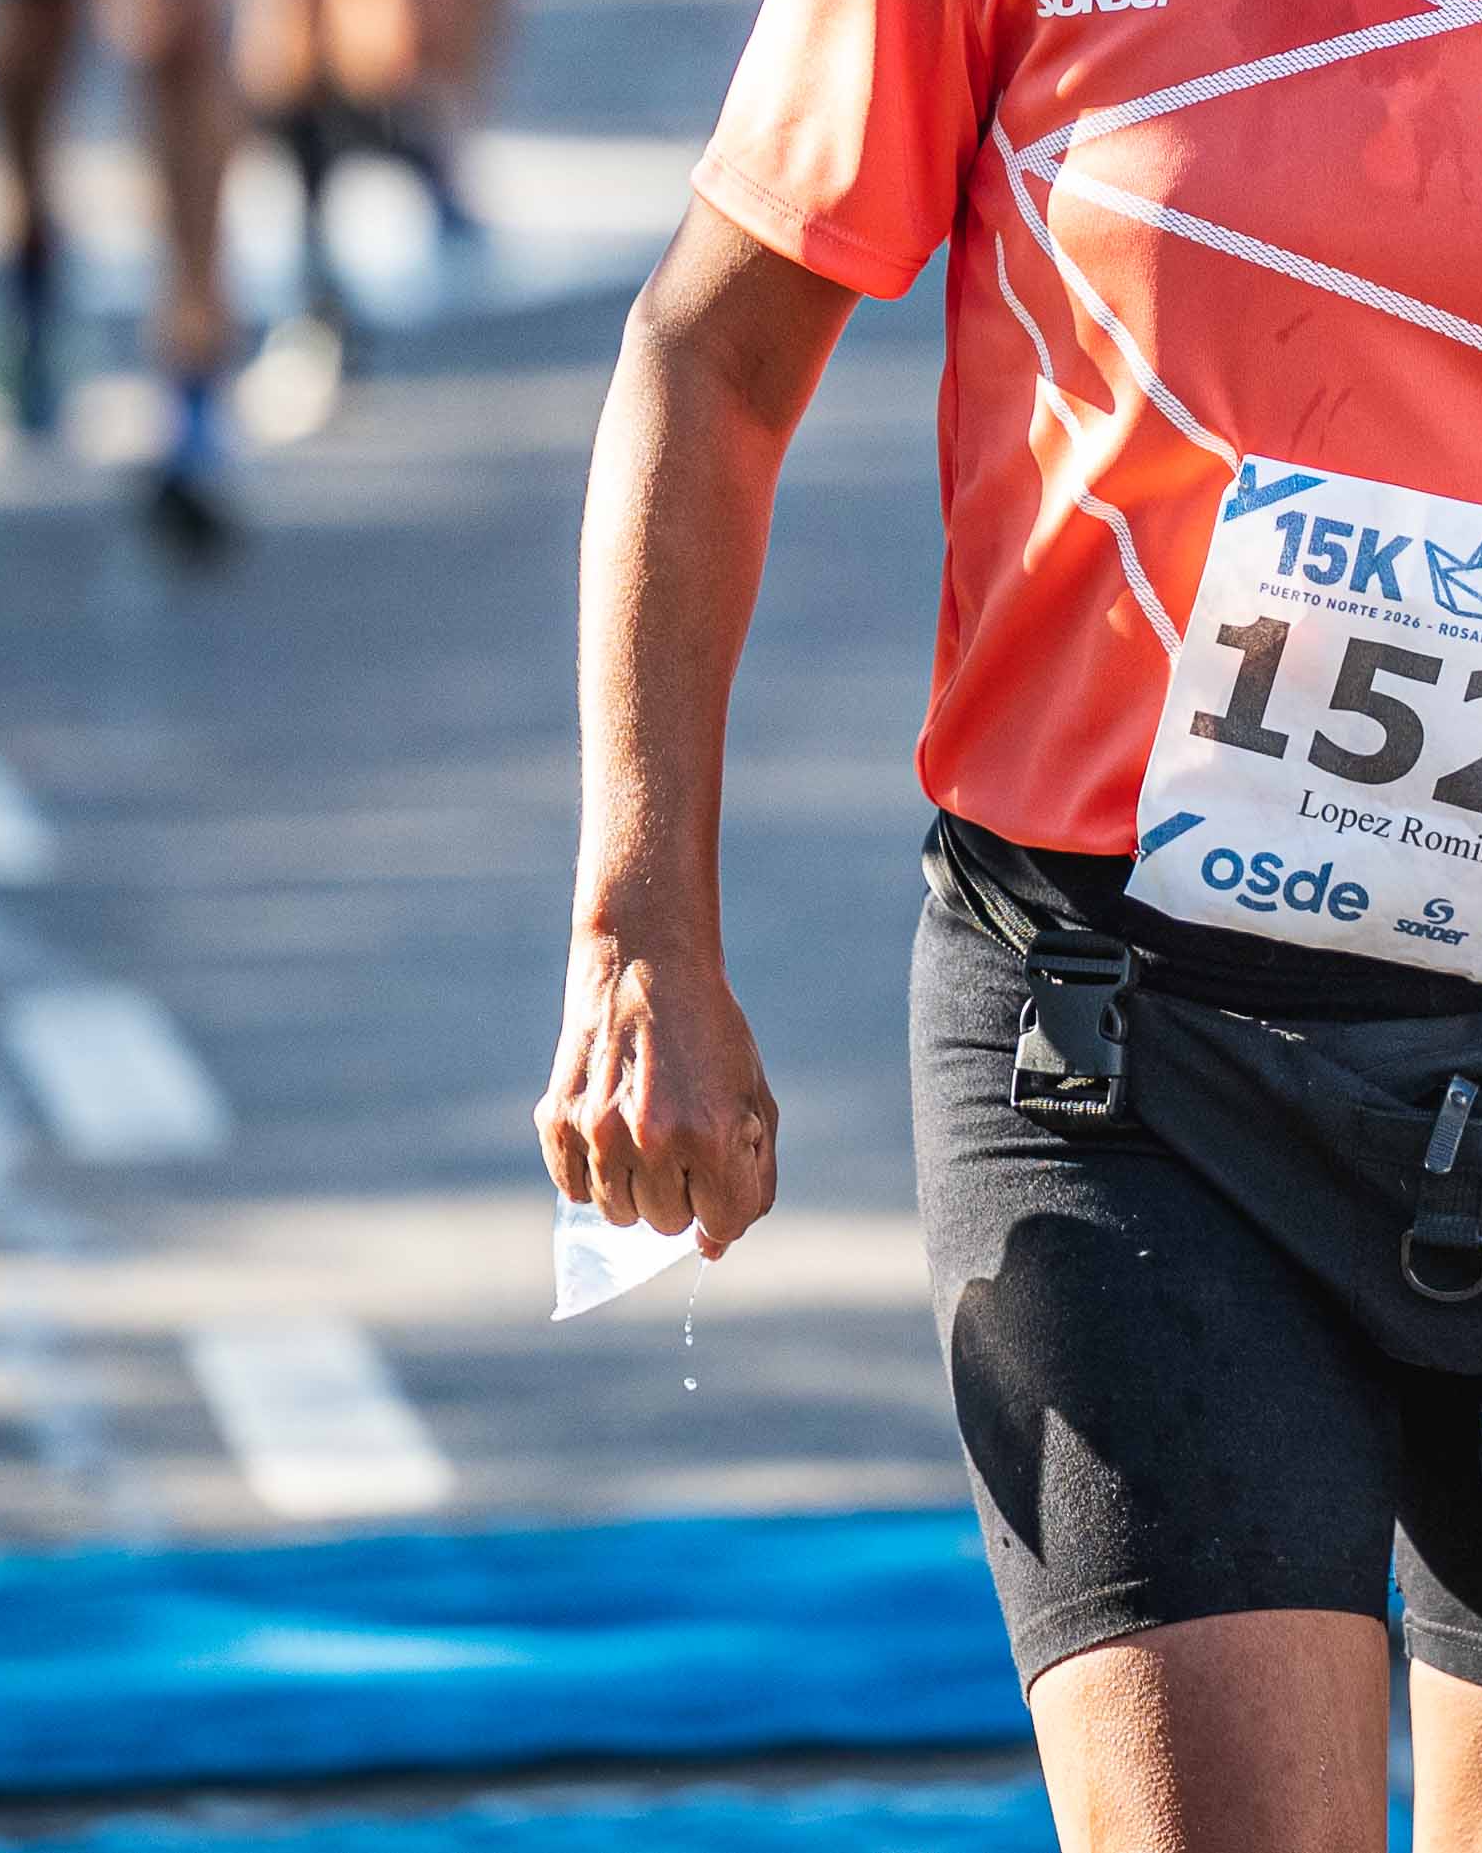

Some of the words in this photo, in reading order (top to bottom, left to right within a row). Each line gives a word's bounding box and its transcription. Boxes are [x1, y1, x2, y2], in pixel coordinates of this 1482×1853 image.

[1275, 509, 1413, 602] 15K
[1259, 582, 1321, 606] PUERTO
[1326, 597, 1378, 619] NORTE
[1384, 610, 1421, 629] 2026
[1297, 789, 1392, 838] Lopez
[1201, 847, 1370, 922] osde
